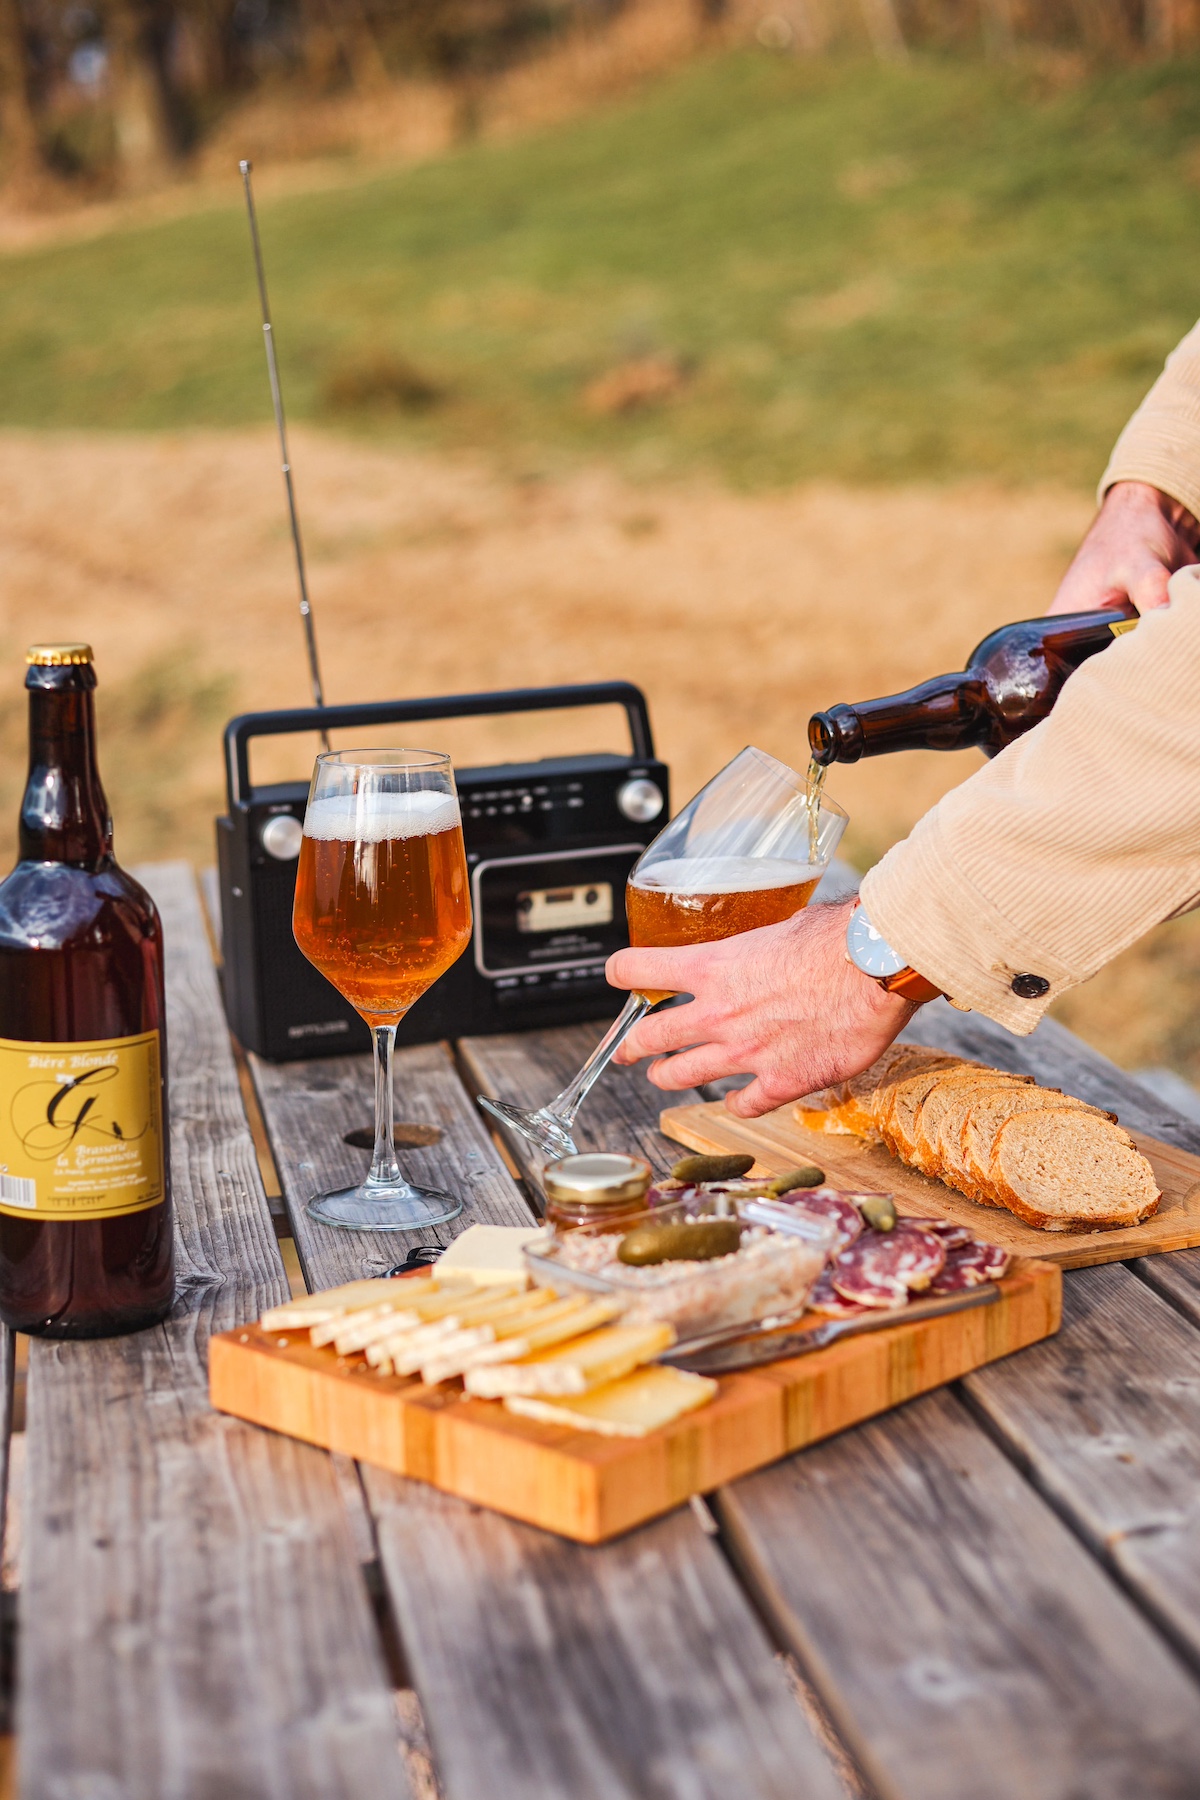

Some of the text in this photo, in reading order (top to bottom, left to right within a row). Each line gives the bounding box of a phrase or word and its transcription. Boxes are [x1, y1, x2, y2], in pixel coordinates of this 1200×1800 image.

[28, 1051, 118, 1068] Bière Blonde
[57, 1153, 69, 1166] la
